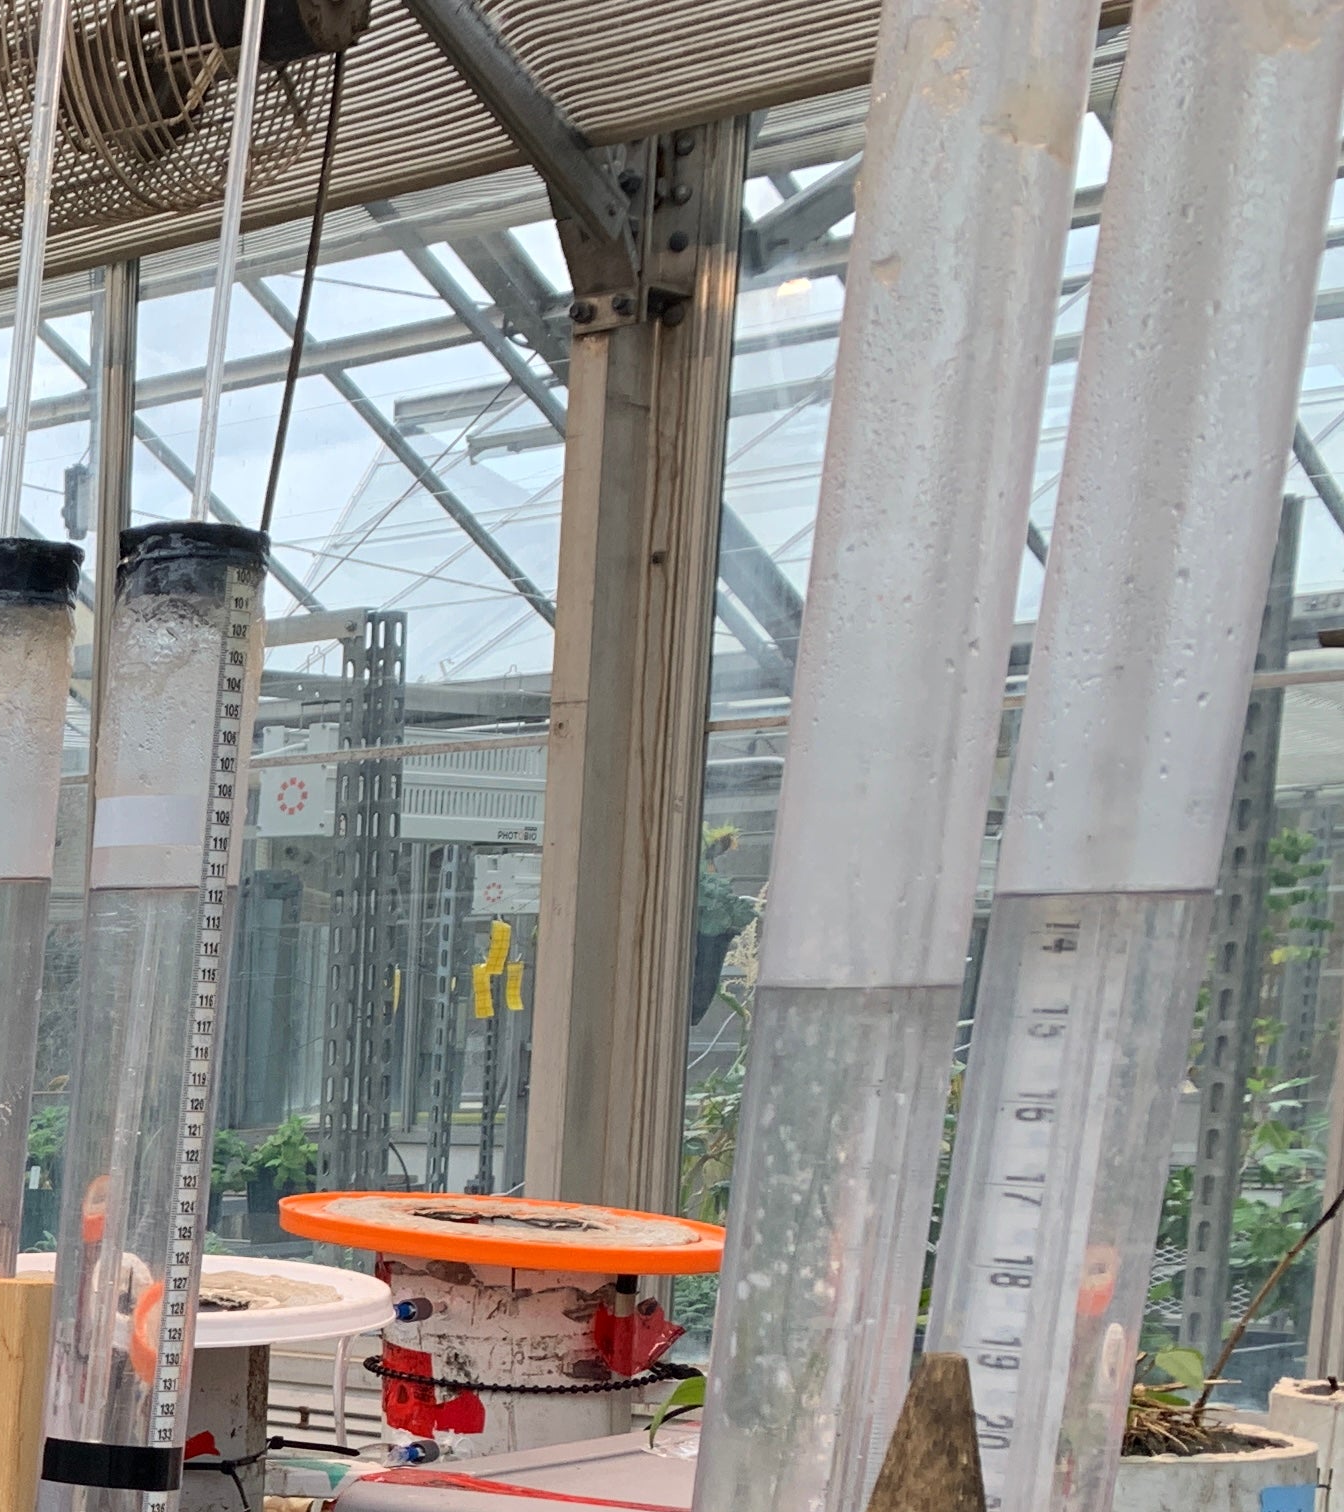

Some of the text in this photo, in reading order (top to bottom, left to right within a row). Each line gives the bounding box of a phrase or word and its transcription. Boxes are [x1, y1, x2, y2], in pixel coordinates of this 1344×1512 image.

[234, 597, 249, 609] 101
[232, 625, 247, 637] 102
[229, 651, 244, 664] 103
[226, 678, 241, 691] 104
[224, 704, 239, 717] 105
[222, 730, 236, 744] 106
[220, 757, 234, 770] 107
[218, 784, 232, 797] 108
[215, 811, 230, 823] 109
[213, 838, 228, 850] 110
[210, 864, 225, 876] 111
[208, 890, 223, 902] 112
[206, 916, 220, 929] 113
[204, 943, 218, 955] 114
[201, 969, 216, 981] 115
[196, 1021, 211, 1033] 117
[1026, 1005, 1070, 1039] 15
[192, 1073, 206, 1085] 119
[190, 1098, 204, 1110] 120
[1015, 1088, 1059, 1122] 16
[187, 1124, 201, 1136] 121
[185, 1150, 199, 1162] 122
[182, 1176, 197, 1188] 123
[1003, 1173, 1046, 1207] 17
[180, 1201, 194, 1213] 124
[178, 1227, 192, 1239] 125
[175, 1252, 189, 1264] 126
[990, 1255, 1034, 1289] 18
[173, 1277, 187, 1289] 127
[168, 1328, 182, 1340] 129
[165, 1353, 179, 1365] 130
[977, 1337, 1022, 1370] 19
[162, 1379, 177, 1391] 131
[160, 1404, 174, 1415] 132
[157, 1429, 172, 1441] 133
